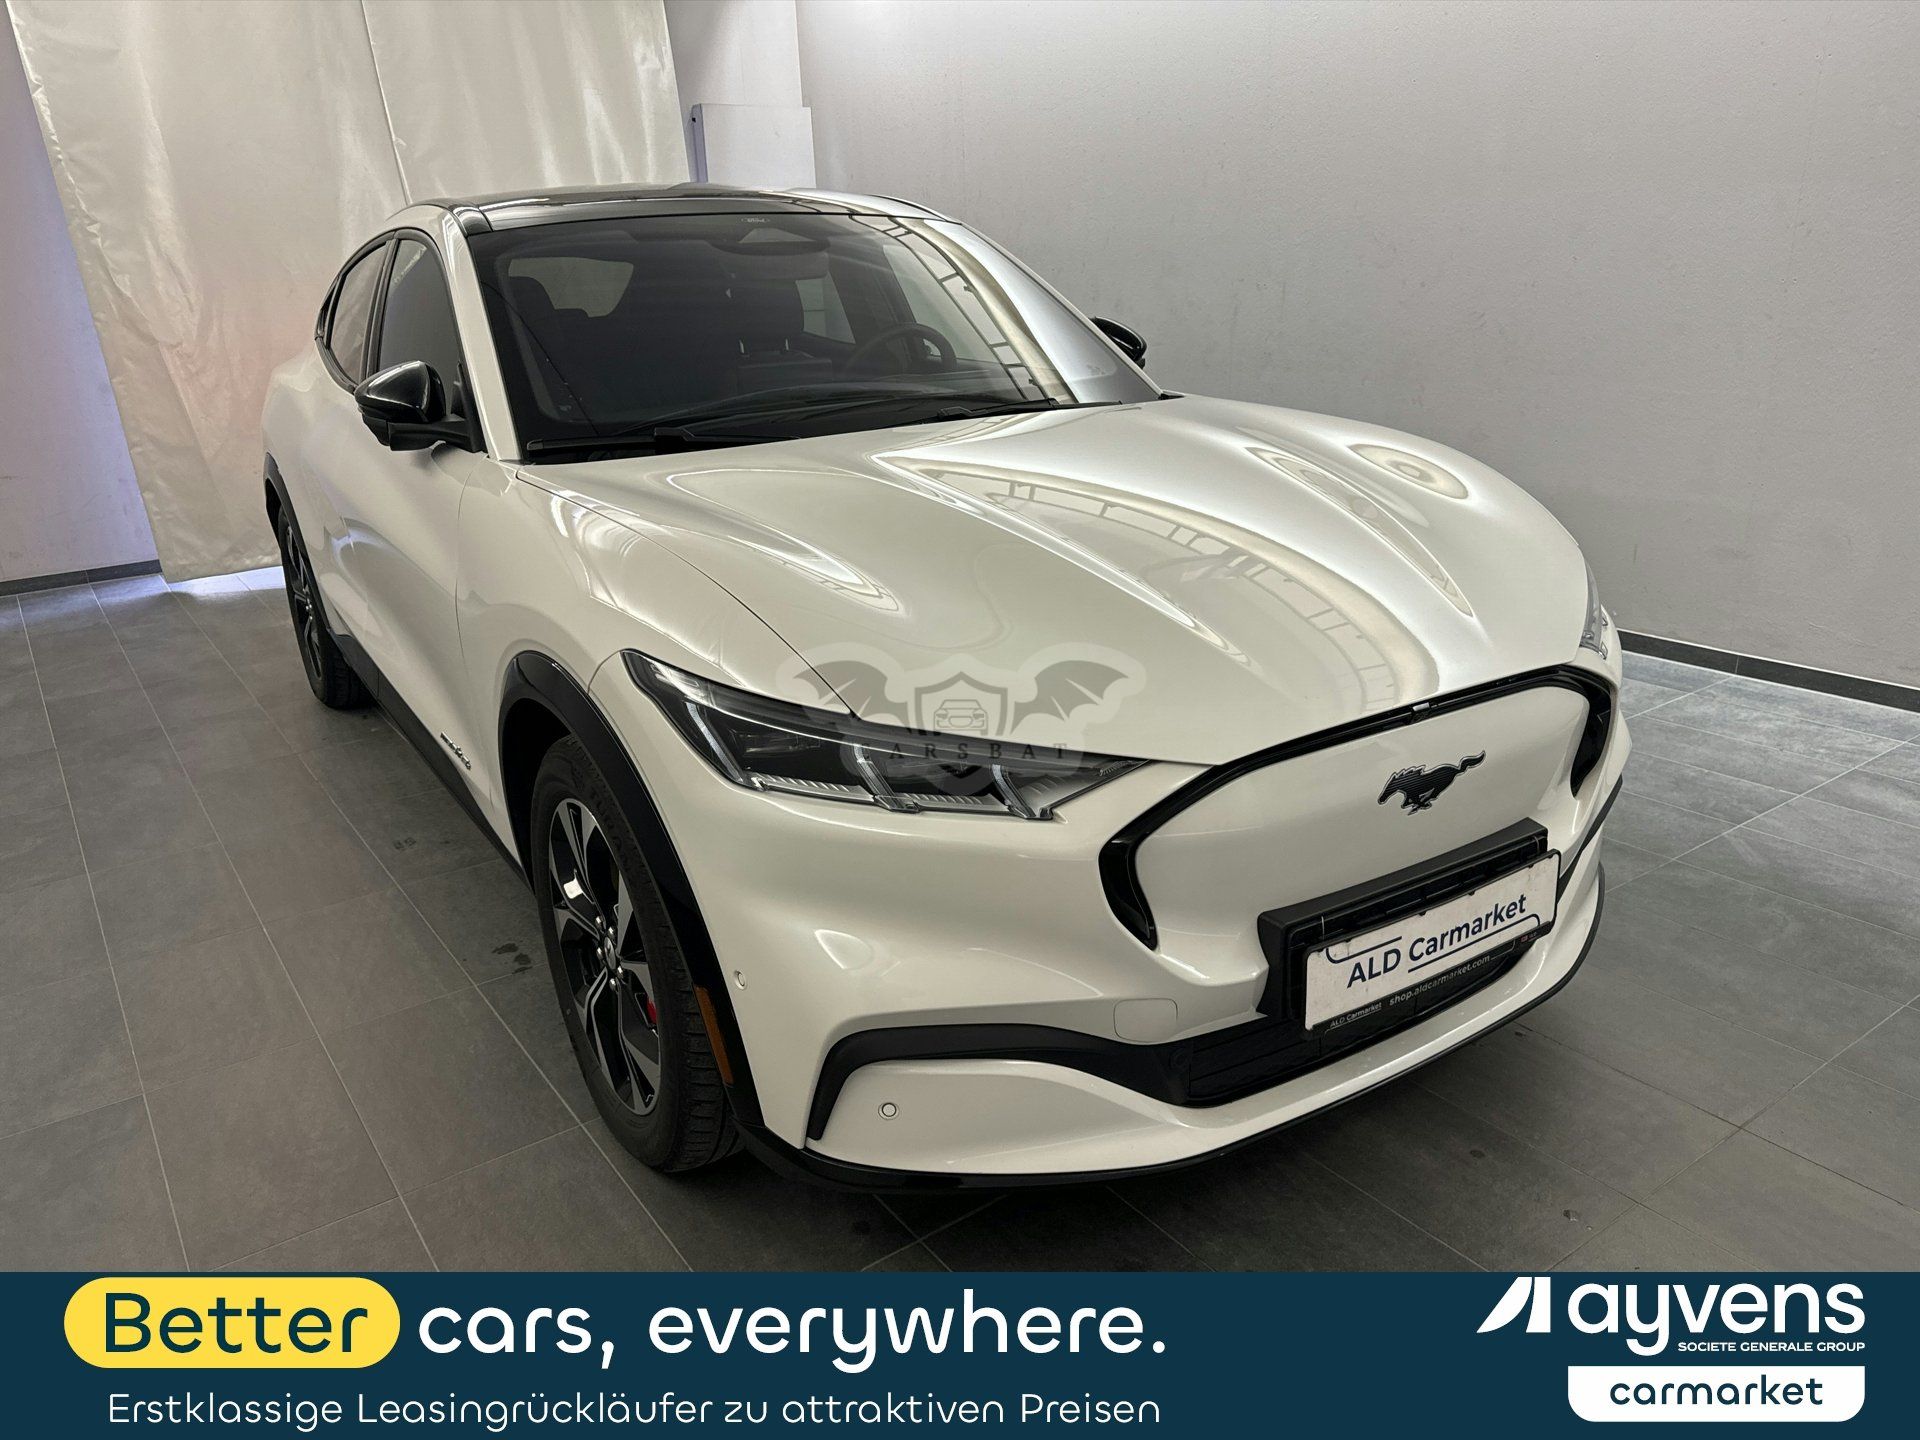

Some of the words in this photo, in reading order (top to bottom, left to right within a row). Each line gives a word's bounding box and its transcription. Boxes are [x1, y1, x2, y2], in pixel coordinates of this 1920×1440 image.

[1346, 948, 1401, 989] ALD
[1408, 893, 1526, 962] Carmarket
[1389, 954, 1490, 1006] shop.aldcarmarket.com
[1329, 1016, 1346, 1028] ALD
[1346, 1001, 1383, 1022] Carmarket
